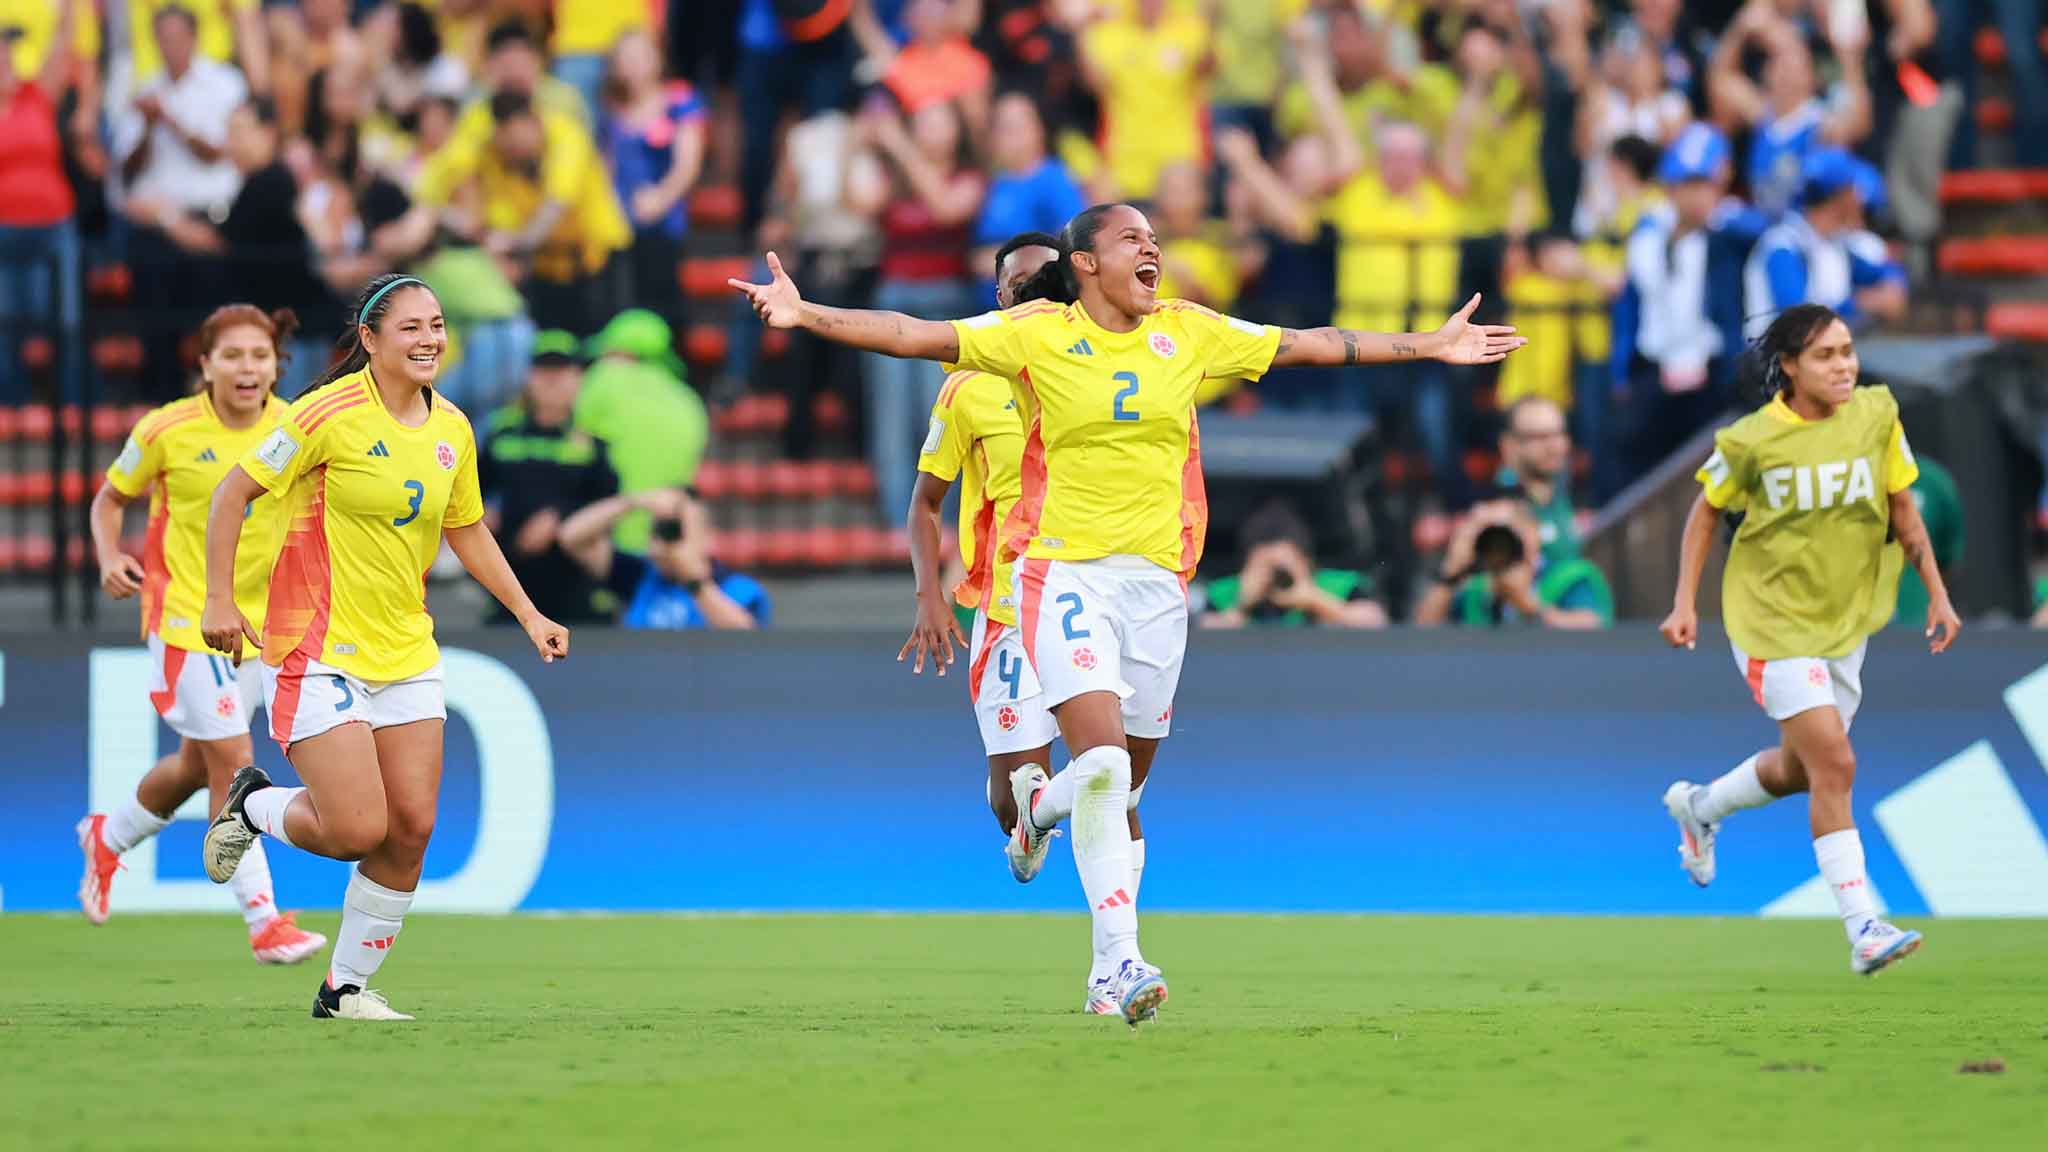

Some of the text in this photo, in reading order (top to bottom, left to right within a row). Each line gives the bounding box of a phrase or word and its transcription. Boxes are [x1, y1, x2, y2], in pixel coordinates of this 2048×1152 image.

[1112, 371, 1140, 420] 2
[393, 480, 425, 526] 3
[1761, 457, 1875, 511] FIFA
[1055, 592, 1090, 640] 2
[998, 649, 1023, 699] 4
